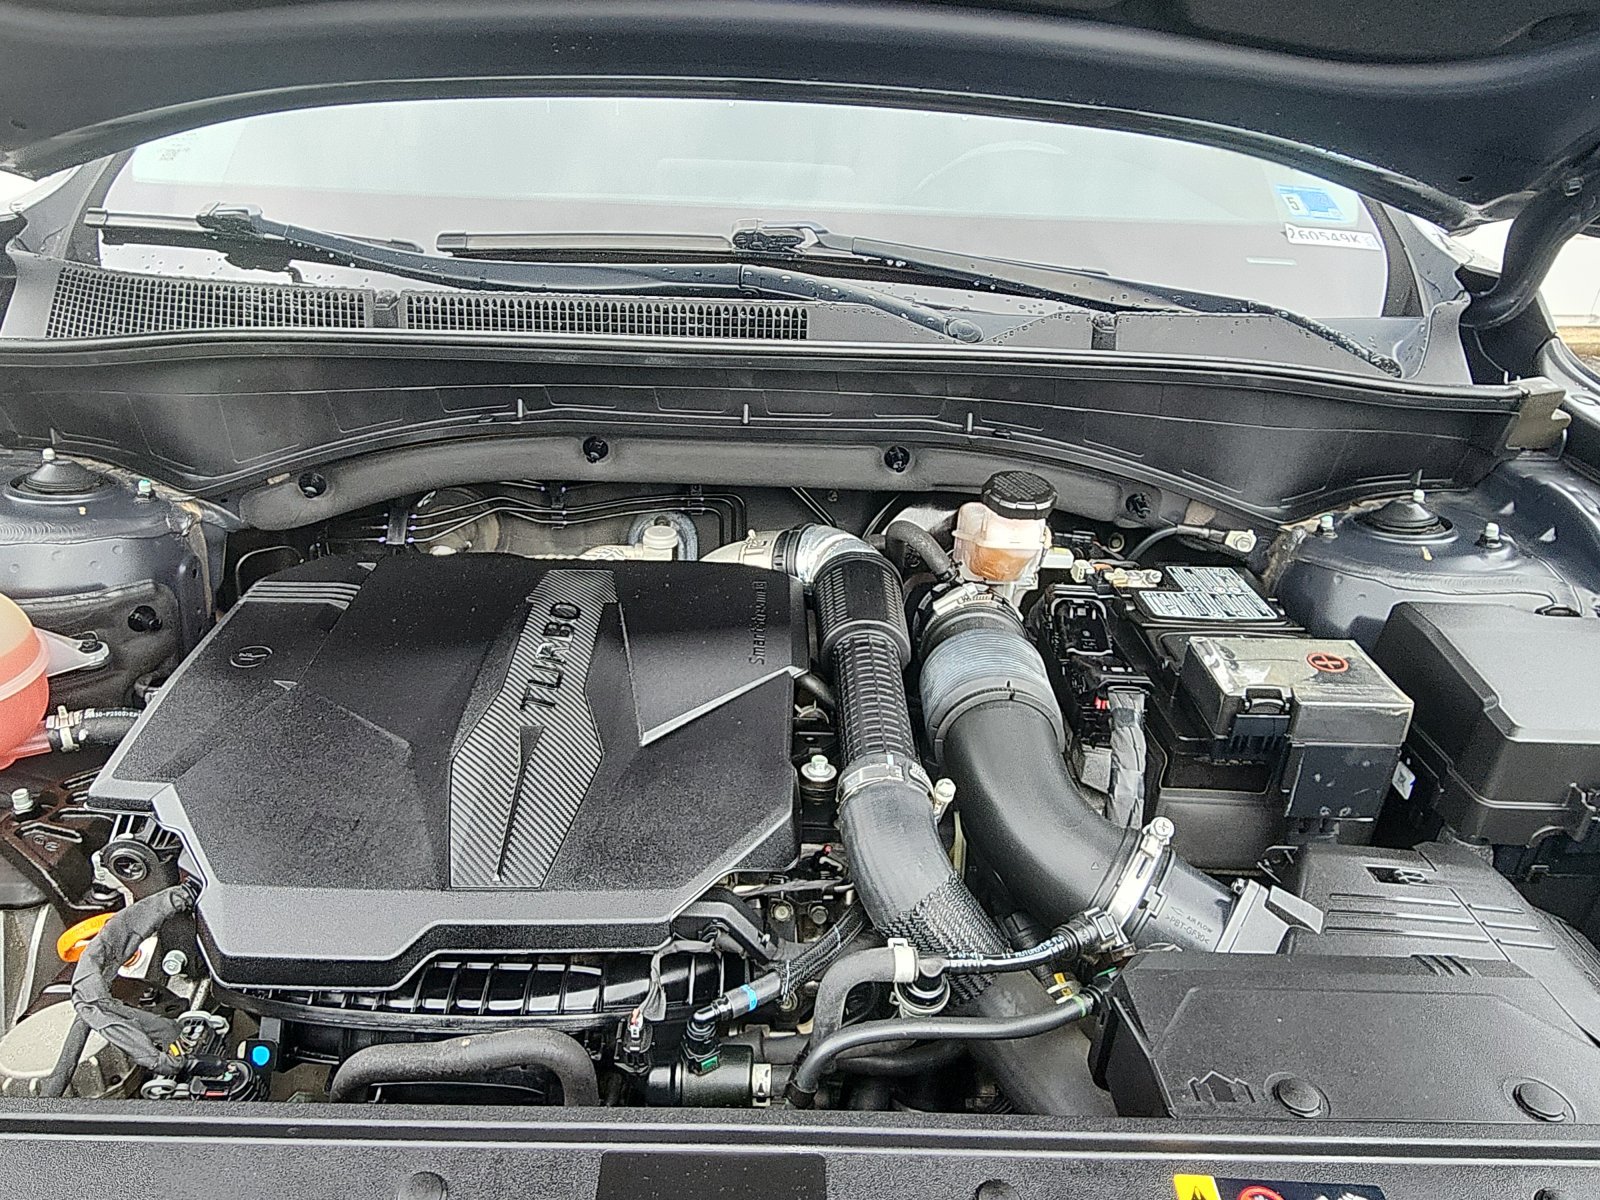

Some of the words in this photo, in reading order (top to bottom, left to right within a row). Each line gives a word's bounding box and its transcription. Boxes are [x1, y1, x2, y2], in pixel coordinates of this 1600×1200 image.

[1286, 197, 1300, 211] 5
[748, 592, 767, 665] Smartstream
[519, 602, 581, 714] TURBO
[1197, 921, 1214, 933] FLOW
